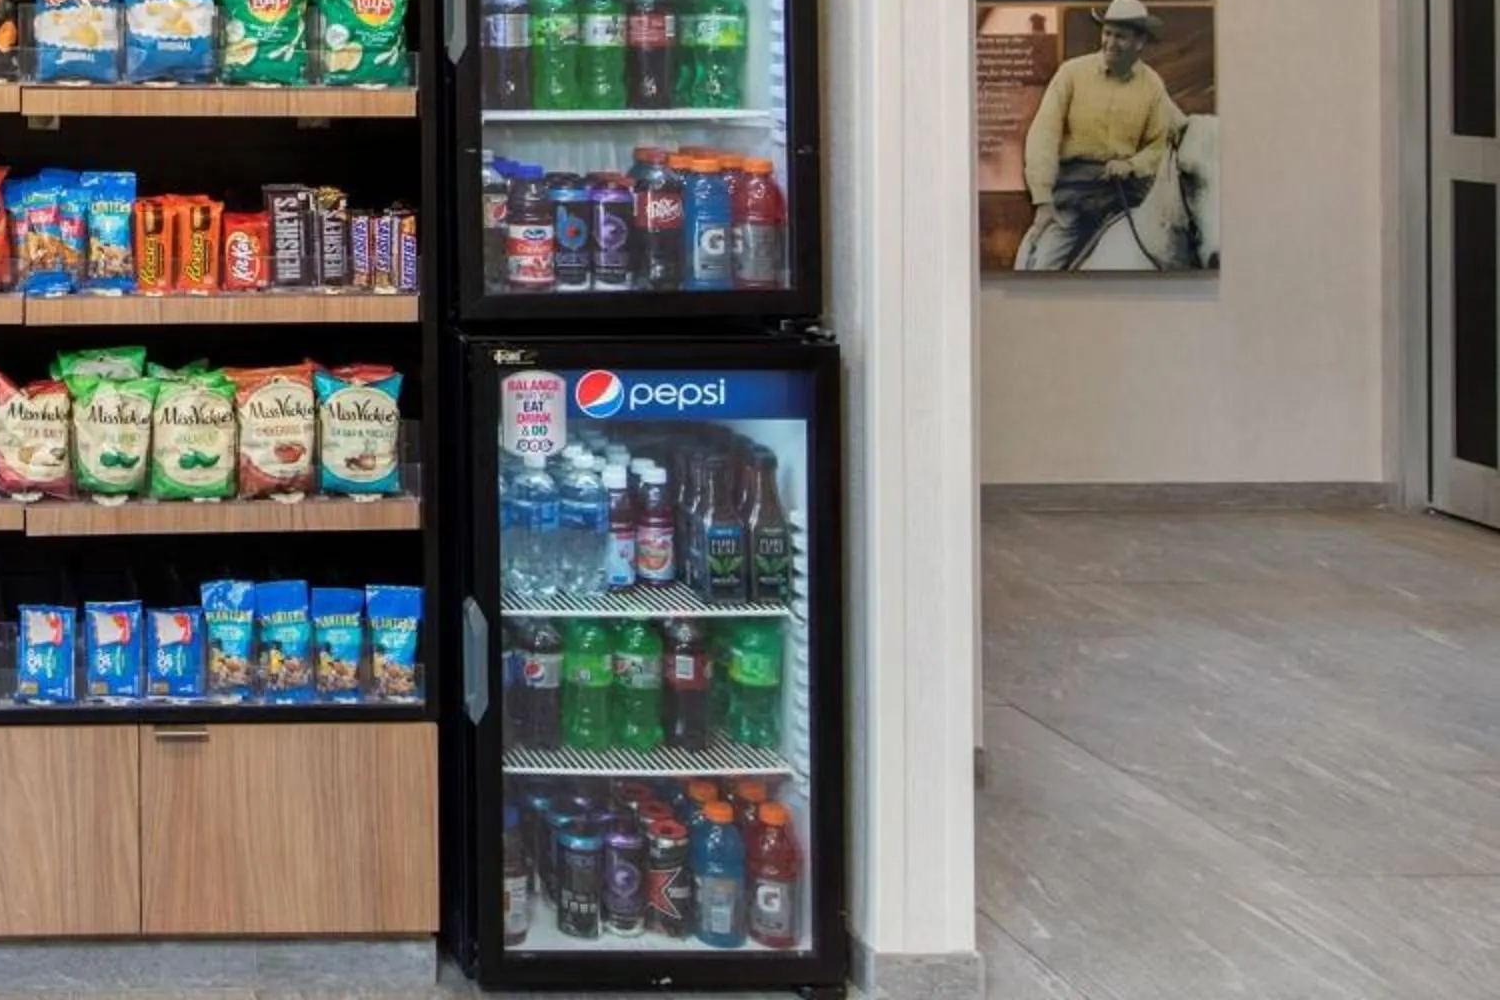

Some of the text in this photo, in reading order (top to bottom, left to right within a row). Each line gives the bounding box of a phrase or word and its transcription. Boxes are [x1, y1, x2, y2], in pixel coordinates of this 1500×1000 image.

[507, 380, 560, 391] BALANCE
[630, 378, 725, 411] pepsi
[328, 401, 356, 421] Miss
[523, 401, 544, 412] EAT
[516, 413, 551, 424] DRINK
[531, 425, 548, 436] DO
